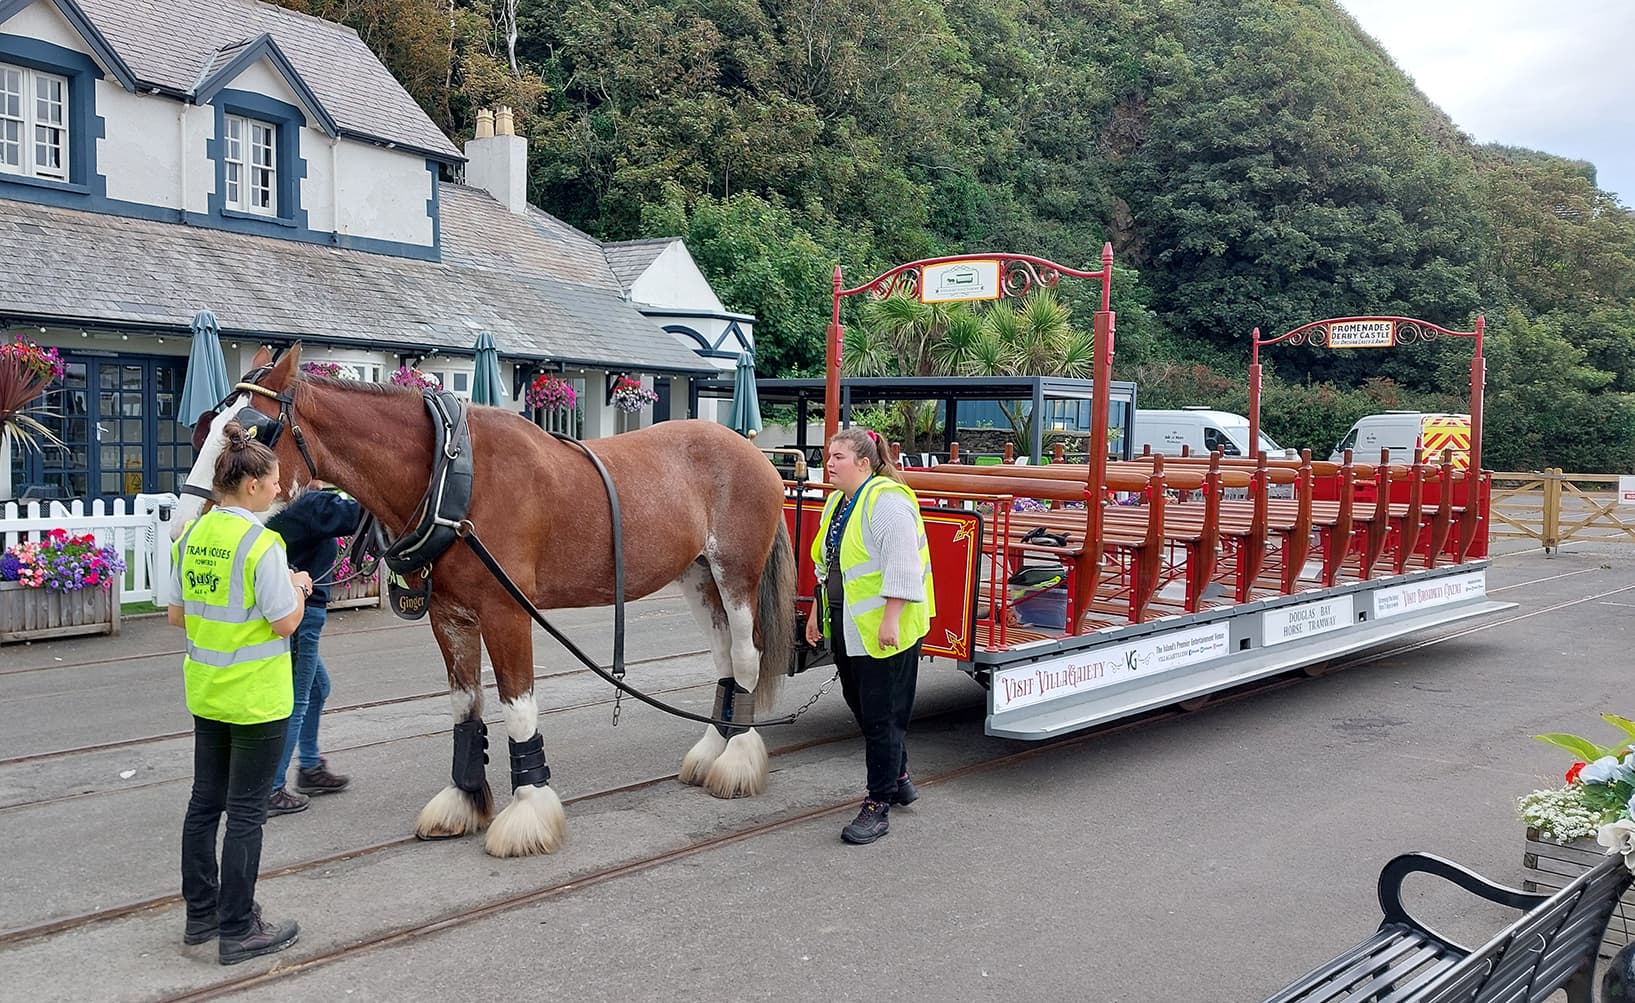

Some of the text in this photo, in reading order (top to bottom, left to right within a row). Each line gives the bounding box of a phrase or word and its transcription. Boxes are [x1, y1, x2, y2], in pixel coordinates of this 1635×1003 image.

[1331, 331, 1390, 340] DERBY CASTLE
[1332, 323, 1390, 333] PROMENADES
[399, 595, 425, 613] Ginger
[1288, 605, 1332, 624] DOUGLAS BAY
[1283, 615, 1337, 637] HORSE TRAMWAY
[1124, 649, 1138, 672] VG
